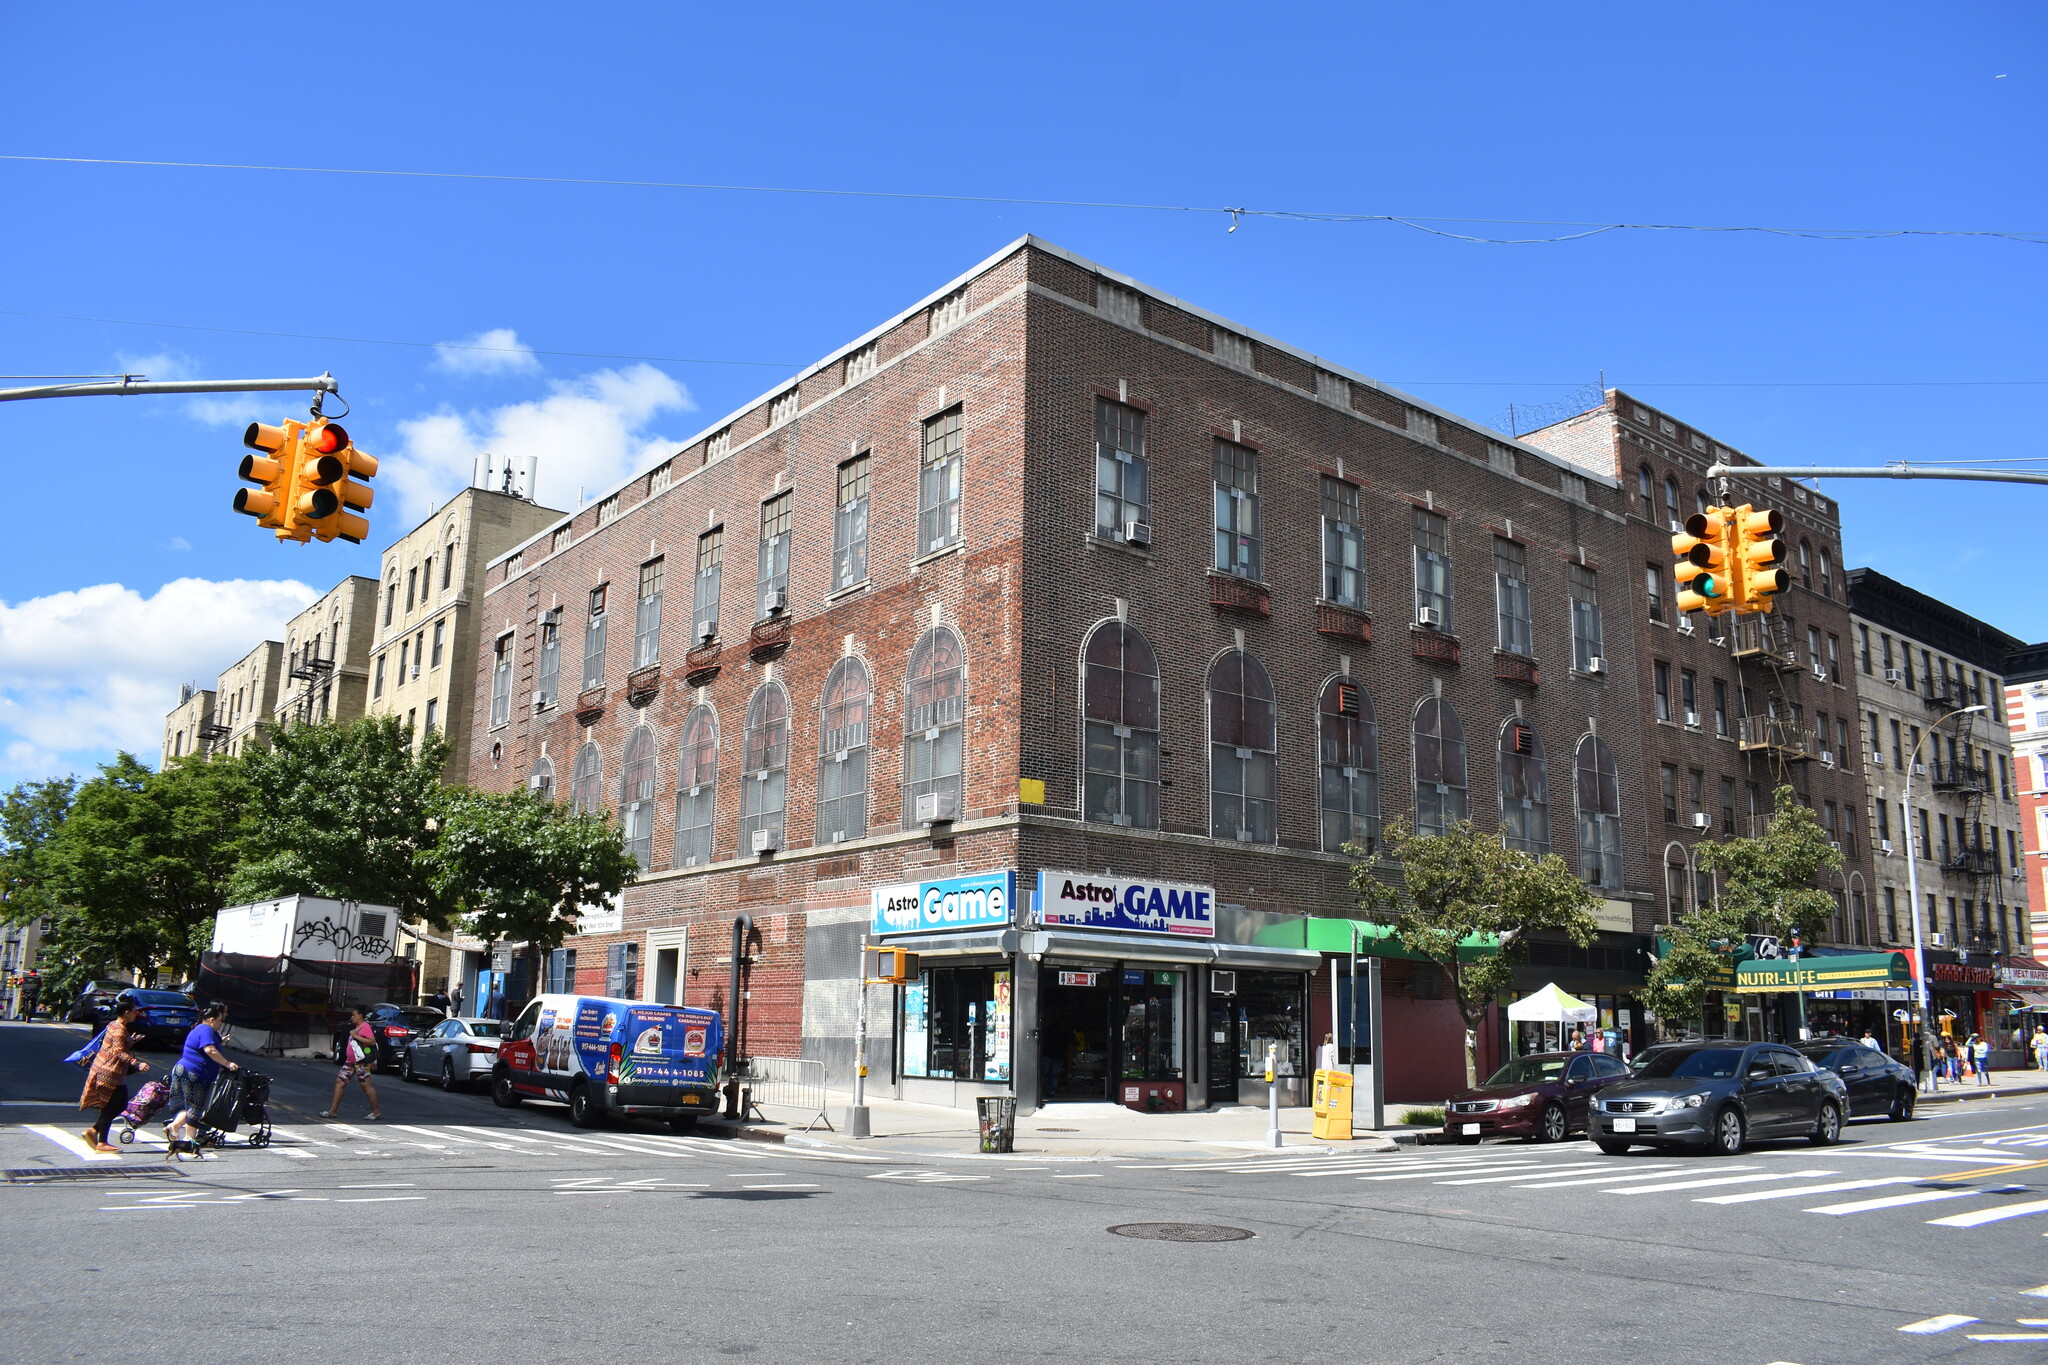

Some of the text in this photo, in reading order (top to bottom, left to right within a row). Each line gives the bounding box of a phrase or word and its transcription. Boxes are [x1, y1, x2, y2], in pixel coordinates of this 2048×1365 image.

[1060, 880, 1114, 903] Astro
[887, 896, 919, 912] Astro
[923, 886, 1005, 924] Game
[1124, 885, 1210, 921] GAME
[1737, 970, 1816, 986] NUTRI-LIFE
[1819, 969, 1886, 979] NUTRITIONAL CENTER
[1934, 964, 1993, 984] BARBERSHOP
[2013, 969, 2029, 980] MEAT
